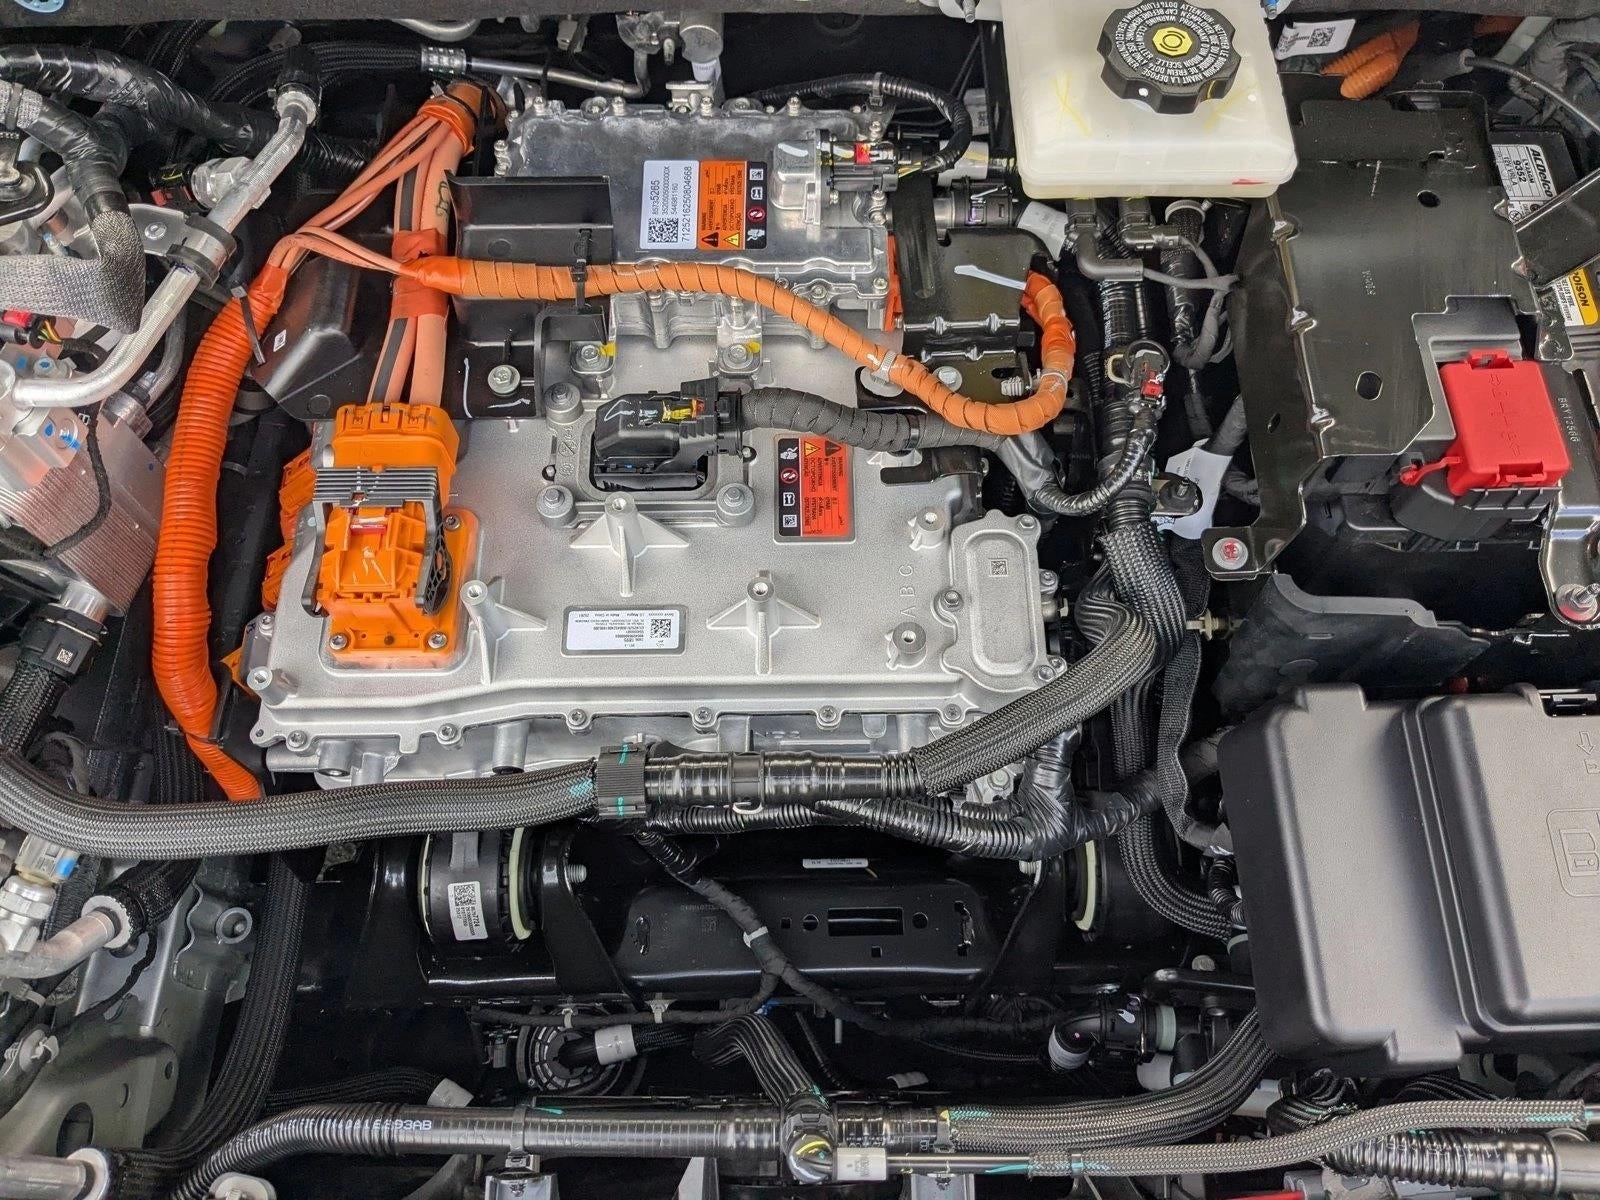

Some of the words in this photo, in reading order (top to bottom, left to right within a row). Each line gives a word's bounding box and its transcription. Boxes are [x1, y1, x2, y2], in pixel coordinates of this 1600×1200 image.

[1125, 7, 1143, 20] FROM
[1140, 2, 1160, 12] FLUID
[1139, 9, 1164, 20] BEFORE
[1180, 4, 1215, 24] ATTENTION:
[1115, 21, 1127, 40] SEALED
[1136, 25, 1148, 41] CLEAN
[1179, 17, 1209, 42] PROVENANT
[1209, 35, 1220, 45] QUE
[1213, 24, 1230, 50] NETTOYER
[1126, 42, 1138, 54] USE
[1136, 42, 1154, 60] FILLER
[1210, 46, 1220, 54] DU
[1132, 52, 1148, 65] ONLY
[1183, 55, 1203, 68] BIDON
[1196, 53, 1217, 71] LIQUIDE
[1148, 63, 1165, 74] DOT4
[1188, 66, 1198, 75] DE
[1202, 57, 1226, 77] BOUCHON
[1183, 73, 1203, 84] AVANT
[1513, 160, 1526, 182] 9352
[1530, 148, 1553, 197] ACDelco
